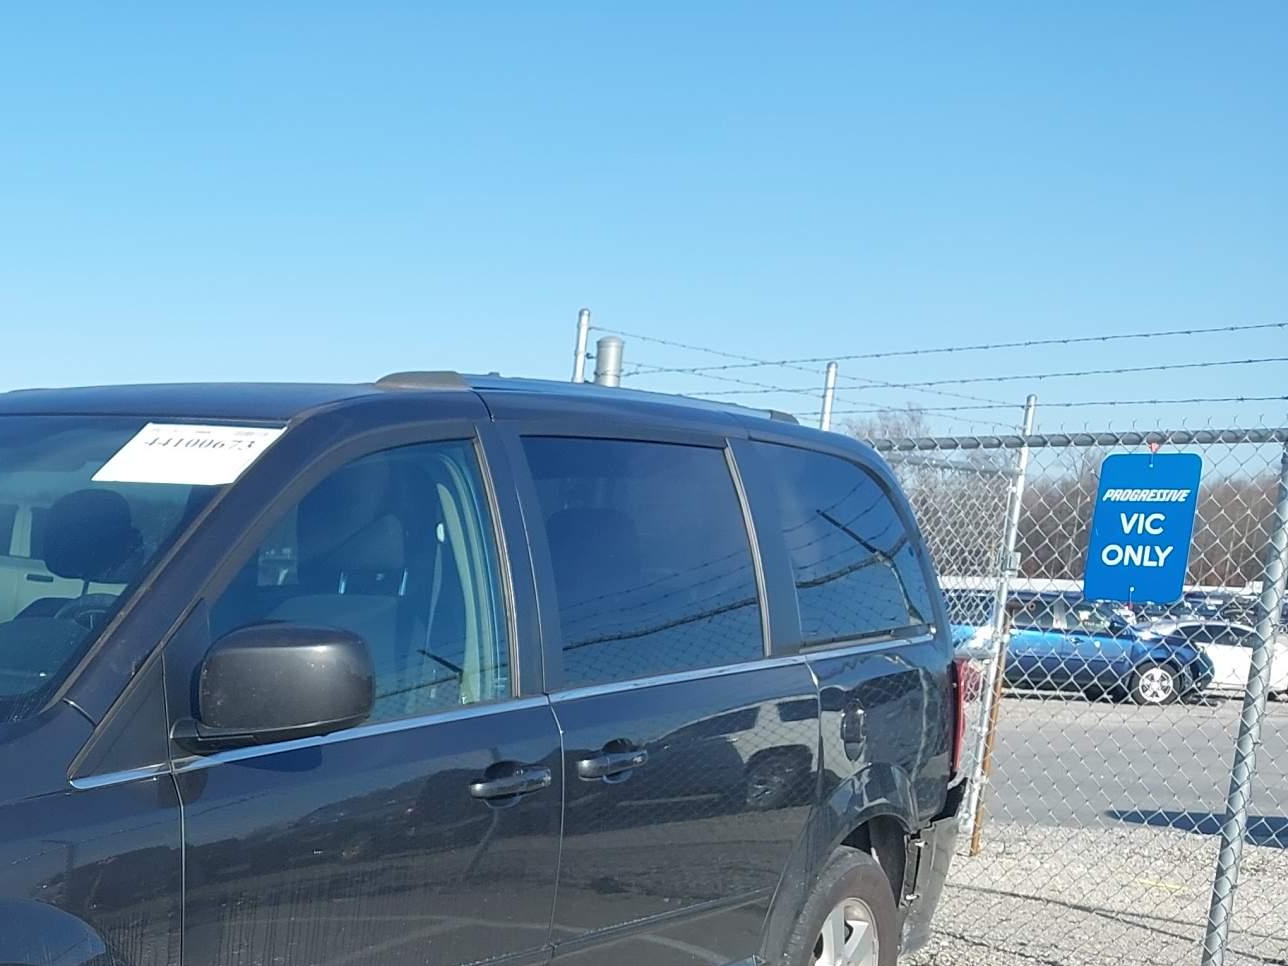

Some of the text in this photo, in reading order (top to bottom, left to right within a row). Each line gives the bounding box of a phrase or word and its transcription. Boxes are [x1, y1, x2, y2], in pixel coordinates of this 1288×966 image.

[1102, 488, 1191, 502] PROGRESSIVE
[1120, 512, 1166, 535] VIC
[1101, 544, 1174, 567] ONLY
